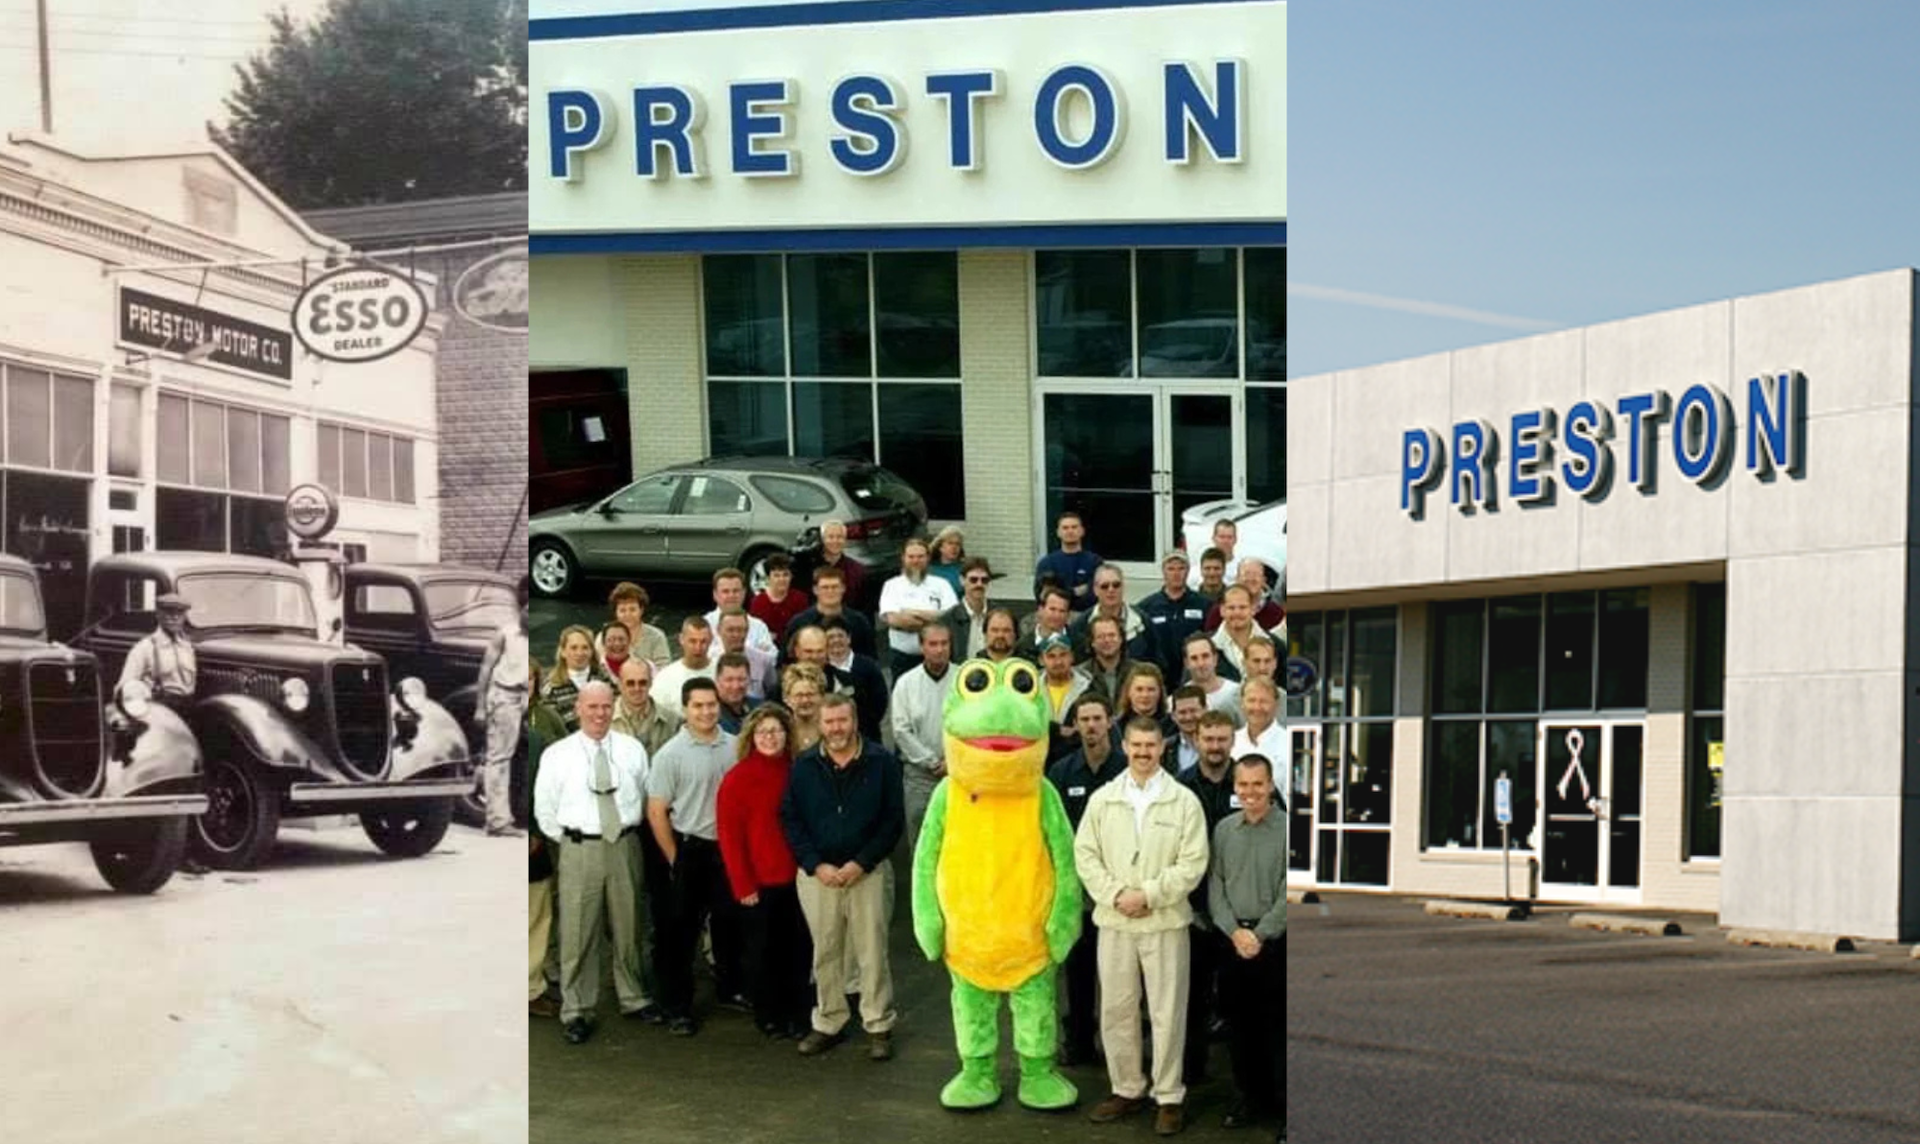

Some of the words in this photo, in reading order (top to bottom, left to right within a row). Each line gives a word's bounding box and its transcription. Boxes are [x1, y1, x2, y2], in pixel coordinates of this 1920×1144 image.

[547, 59, 1244, 180] PRESTON
[332, 278, 390, 293] STANDARD
[128, 303, 206, 345] PRESTON
[211, 325, 258, 358] MOTOR
[261, 338, 283, 366] CO.
[309, 294, 410, 335] ESSO
[334, 337, 383, 351] DEALER
[1400, 371, 1793, 513] PRESTON
